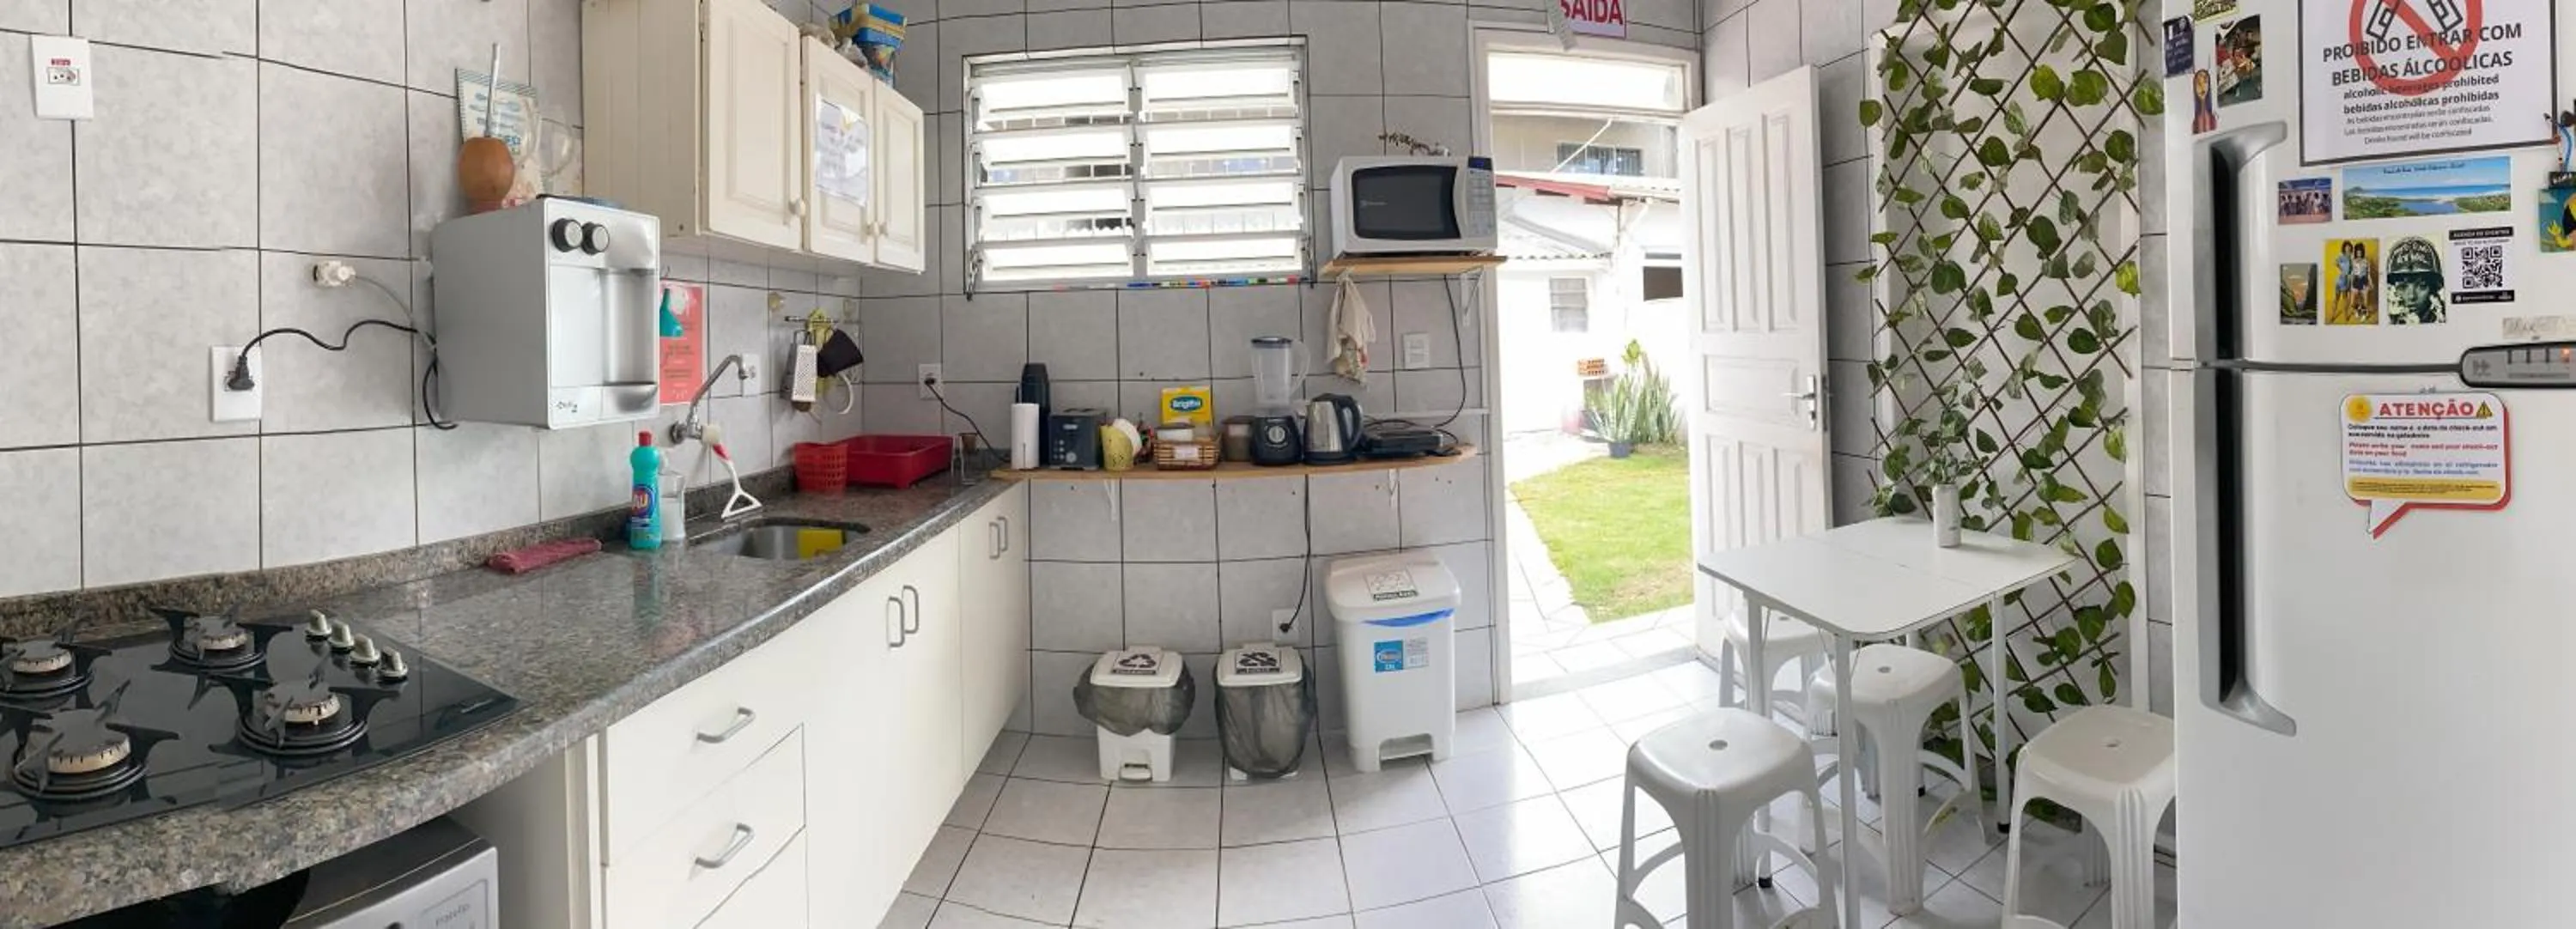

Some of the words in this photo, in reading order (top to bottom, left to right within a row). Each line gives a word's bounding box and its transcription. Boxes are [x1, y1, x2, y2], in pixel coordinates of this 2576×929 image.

[2323, 36, 2402, 62] PROIBIDO
[2406, 29, 2474, 51] ENTRAR
[2479, 23, 2522, 41] COM
[2331, 63, 2398, 87] BEBIDAS
[2403, 51, 2512, 76] ÁLCOOLICAS
[2444, 74, 2500, 90] prohibited
[2343, 102, 2383, 114] bebidas
[2441, 90, 2500, 106] prohibidas
[2379, 398, 2474, 420] ATENÇÃO
